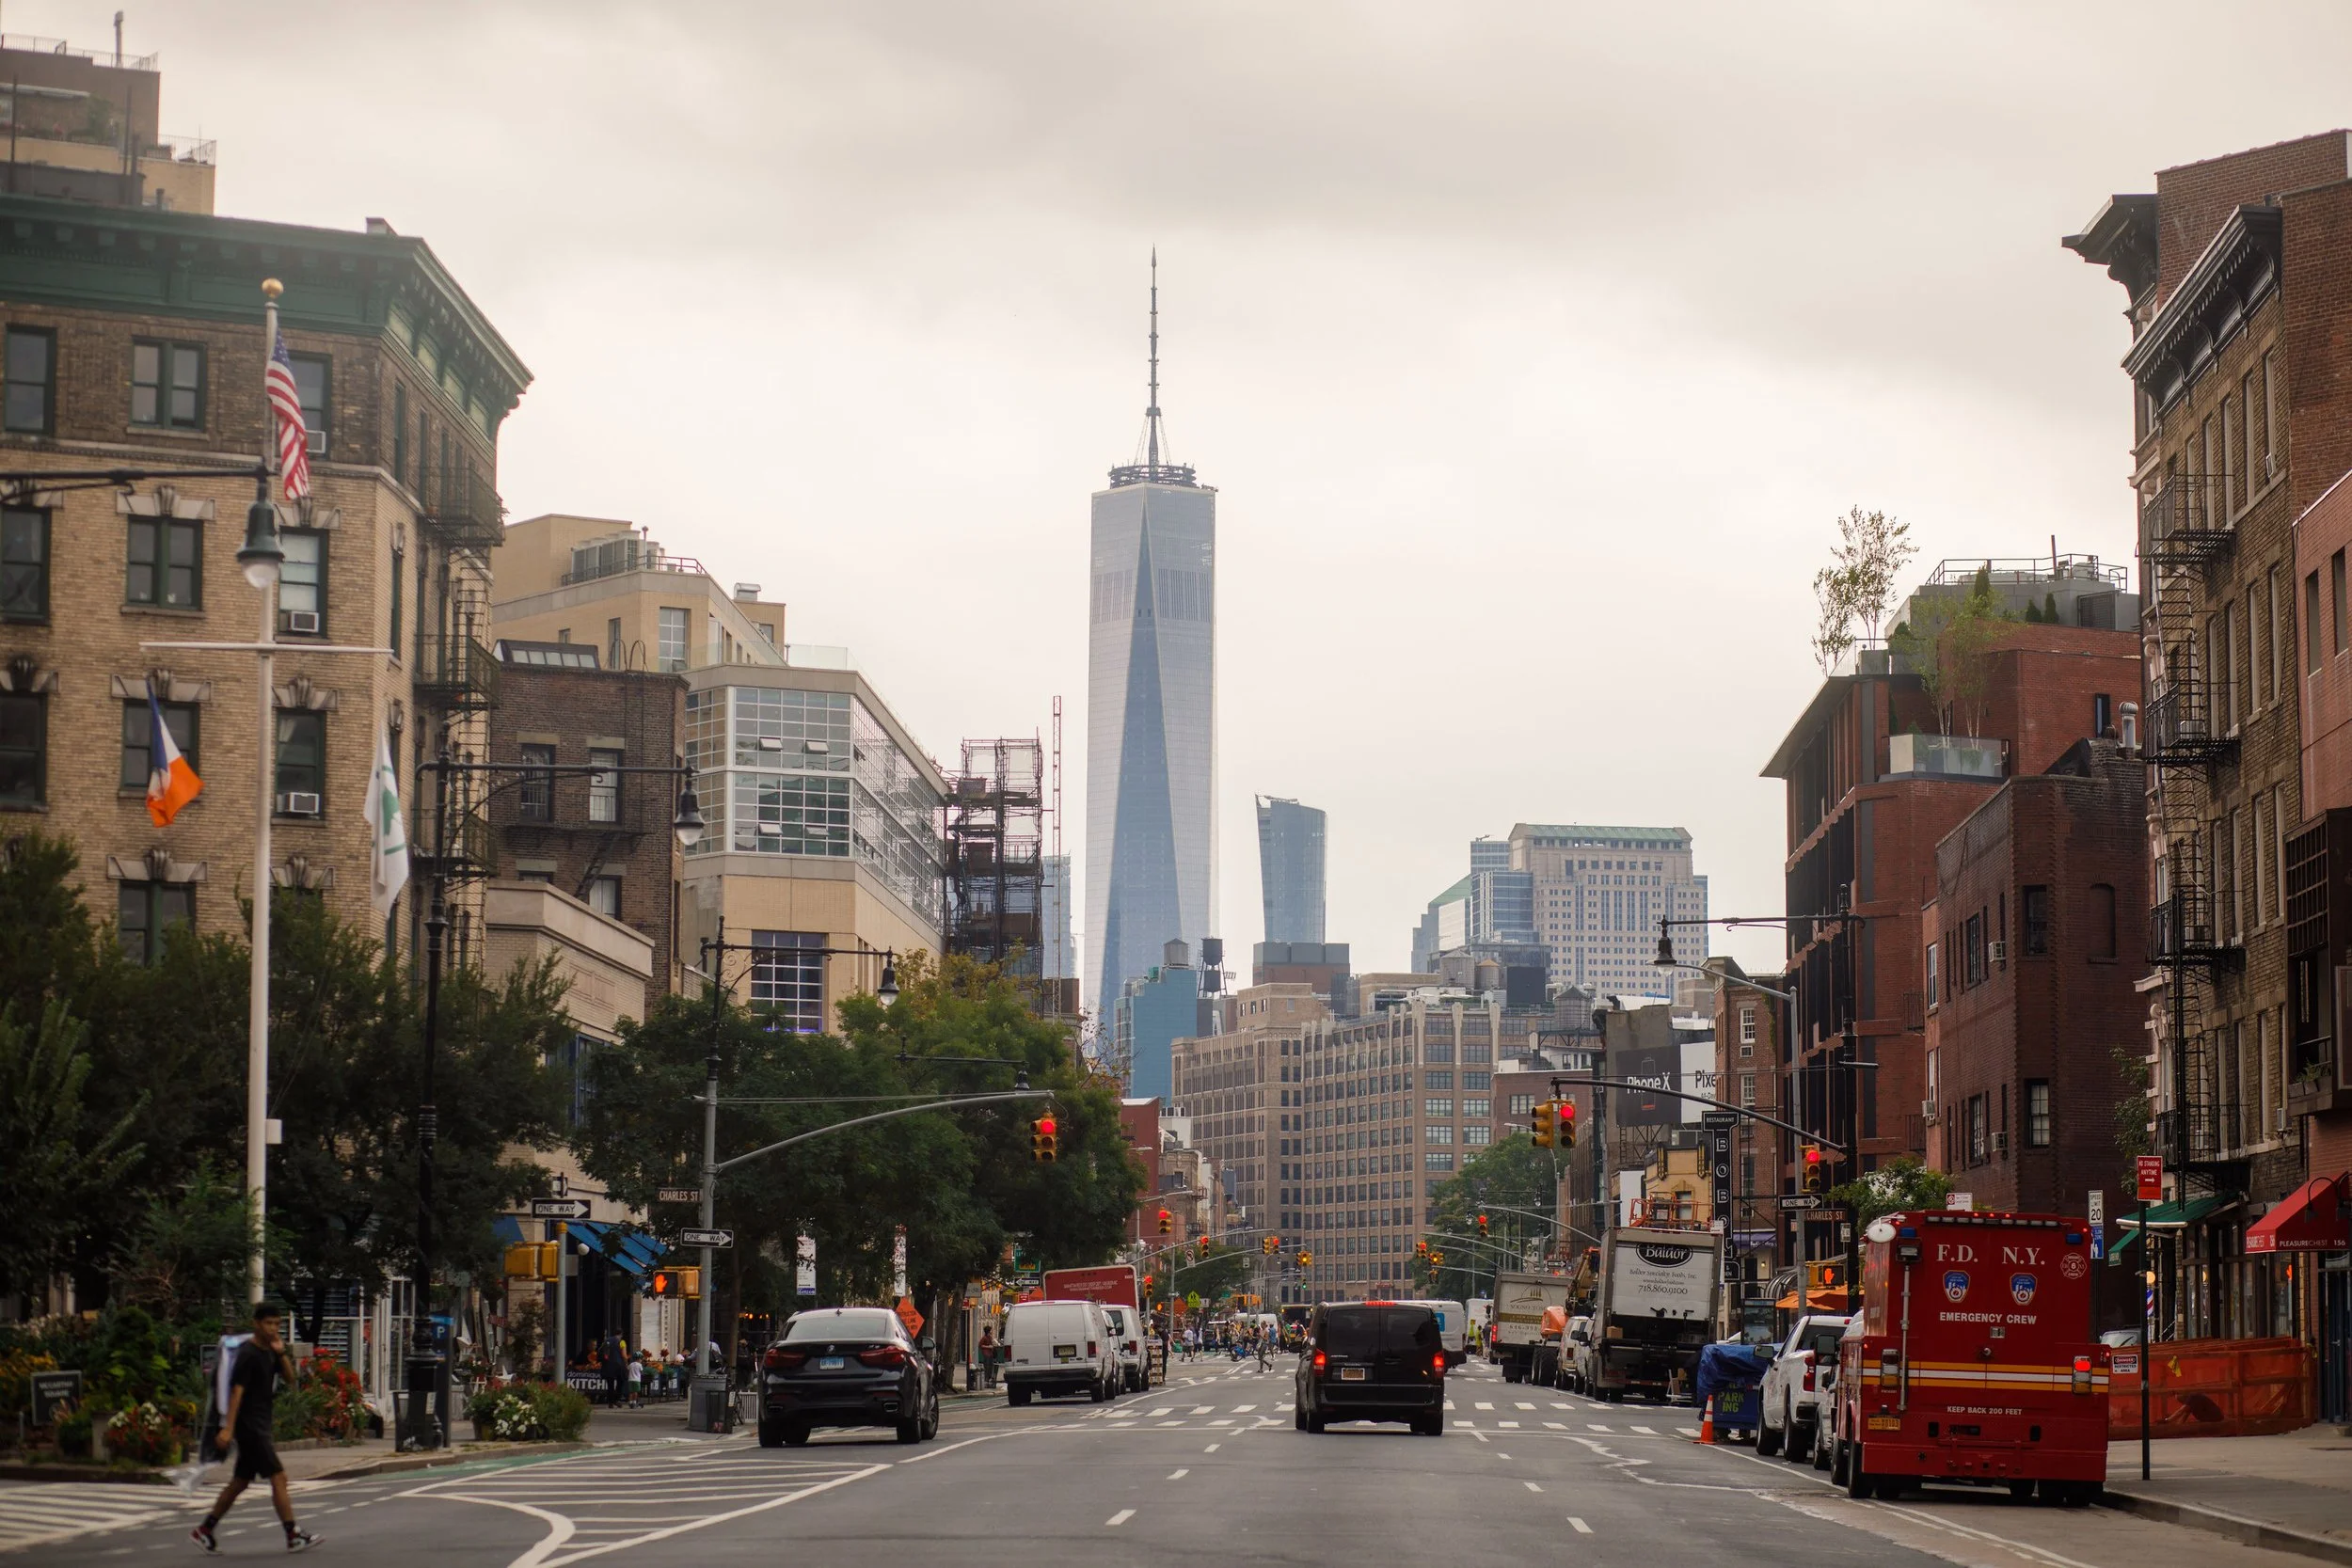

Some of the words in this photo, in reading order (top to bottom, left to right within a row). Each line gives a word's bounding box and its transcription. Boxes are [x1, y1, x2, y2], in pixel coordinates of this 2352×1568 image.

[659, 1191, 688, 1201] CHARLES
[690, 1191, 699, 1201] ST
[1785, 1198, 1798, 1207] ONE
[538, 1205, 554, 1213] ONE
[558, 1205, 575, 1213] WAY
[1806, 1211, 1833, 1221] CHARLES
[1836, 1211, 1843, 1221] ST
[2091, 1209, 2102, 1221] 20
[685, 1233, 701, 1242] ONE
[2279, 1239, 2328, 1247] PLEASURECHEST
[1936, 1243, 1979, 1263] F.D.
[2002, 1246, 2046, 1266] N.Y.
[1638, 1284, 1688, 1295] 718.860.9100
[1939, 1311, 2003, 1323] EMERGENCY
[2006, 1314, 2037, 1325] CREW
[566, 1370, 601, 1379] dominiqu
[1718, 1392, 1744, 1402] PARK
[1723, 1402, 1740, 1413] ING
[1947, 1405, 1965, 1414] KEEP
[1967, 1406, 1987, 1415] BACK
